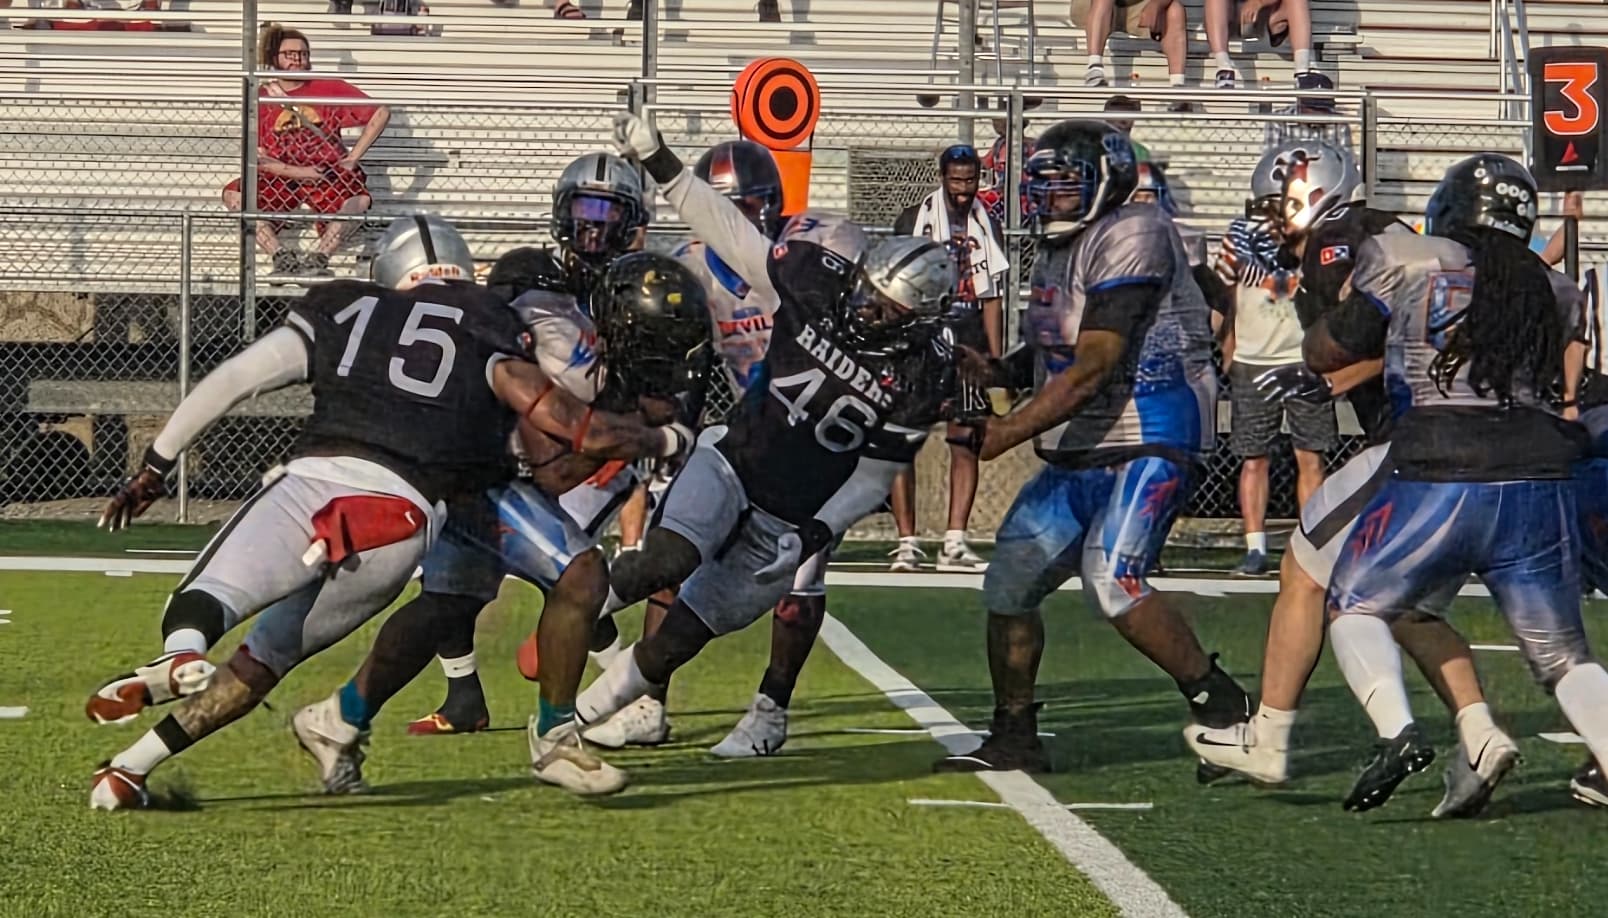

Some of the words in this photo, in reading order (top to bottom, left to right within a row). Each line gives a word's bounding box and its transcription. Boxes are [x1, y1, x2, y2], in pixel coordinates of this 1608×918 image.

[1543, 62, 1599, 136] 3
[333, 295, 464, 398] 15
[795, 323, 893, 408] RAIDERS
[768, 367, 878, 453] 46
